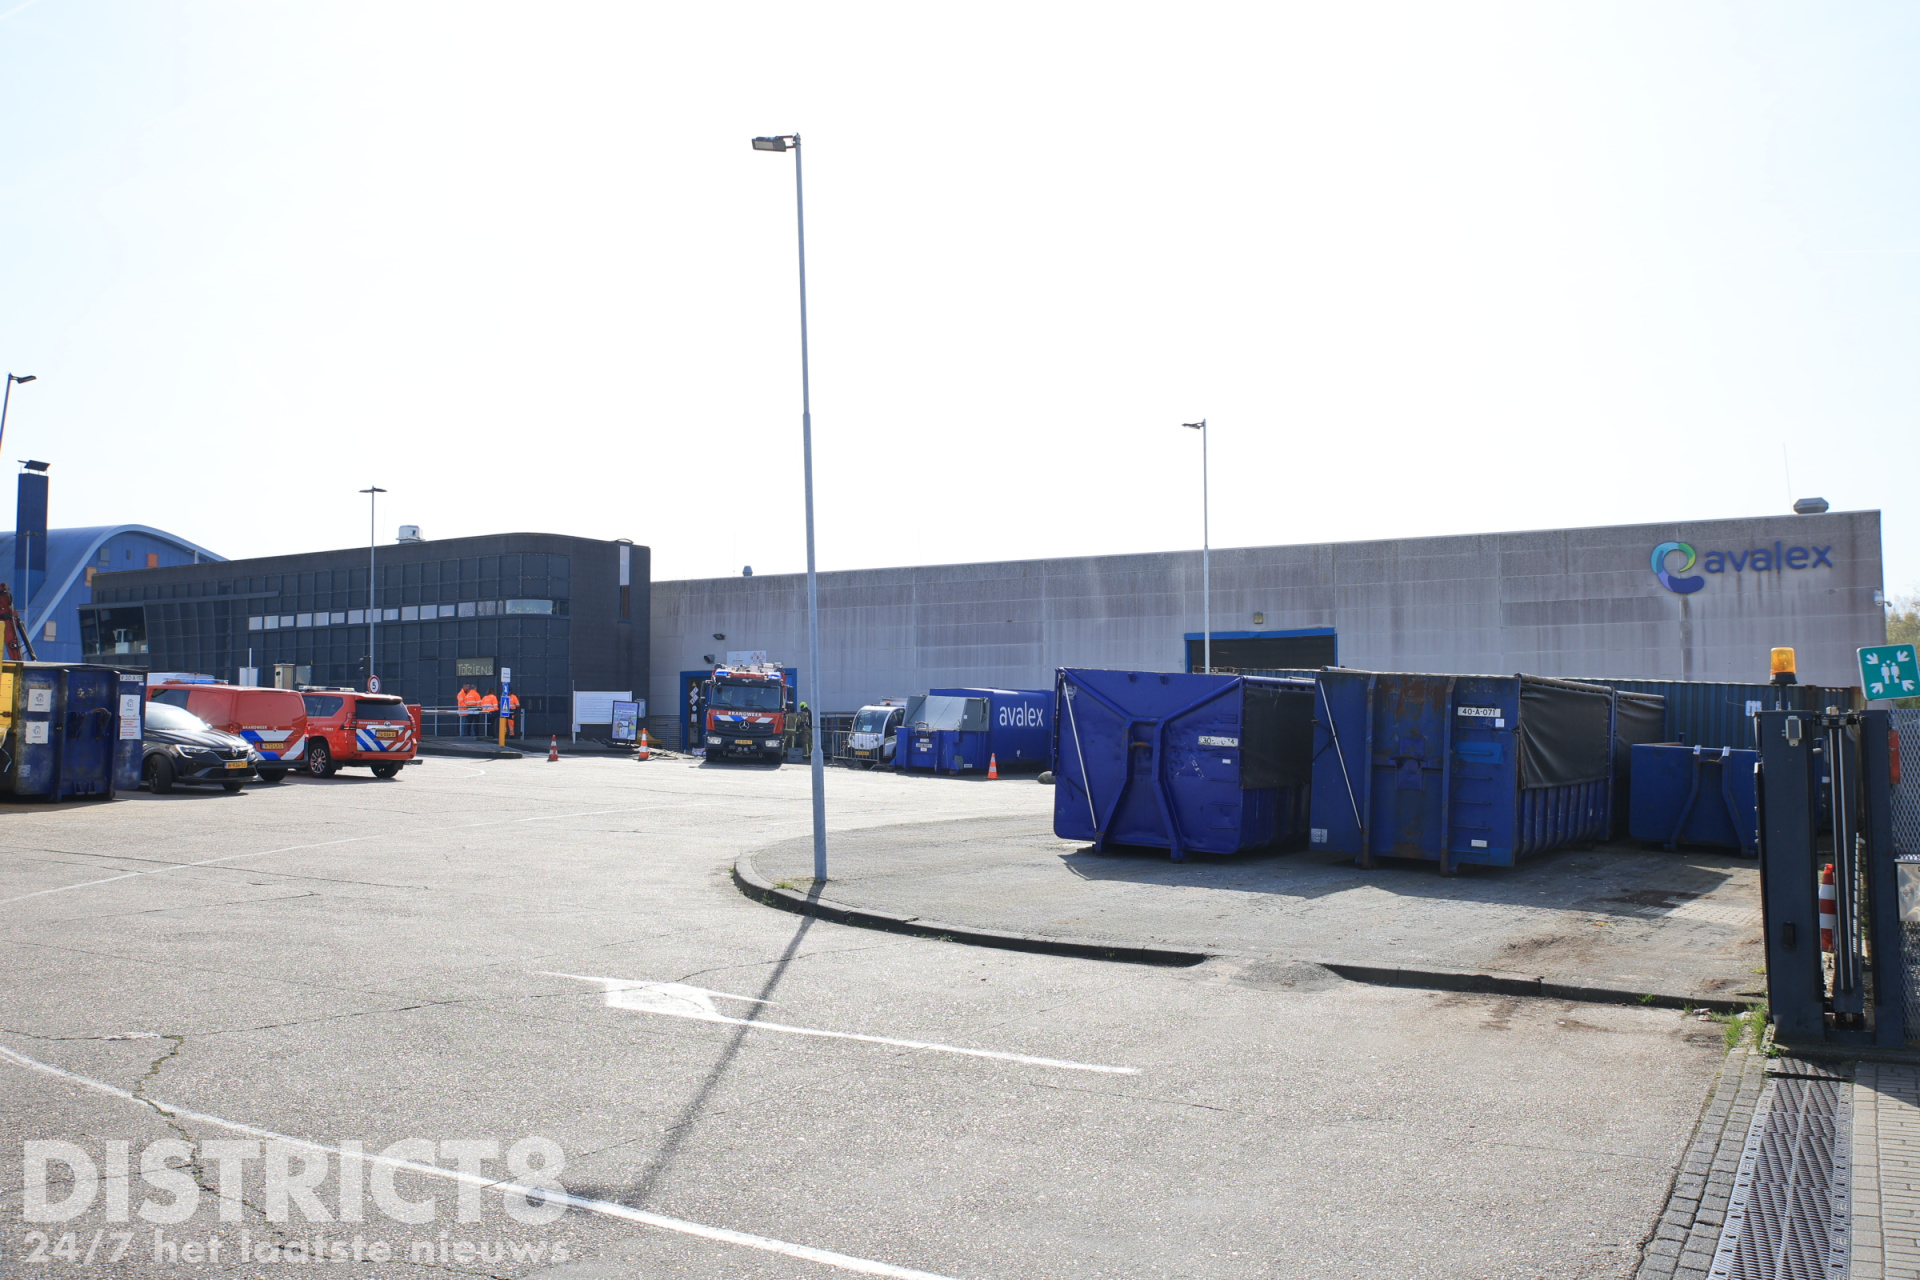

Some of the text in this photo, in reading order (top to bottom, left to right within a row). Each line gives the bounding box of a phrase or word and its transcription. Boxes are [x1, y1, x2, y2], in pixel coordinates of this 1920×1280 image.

[1704, 540, 1833, 574] avalex
[999, 700, 1044, 727] avalex
[1462, 708, 1496, 716] 40-A-071
